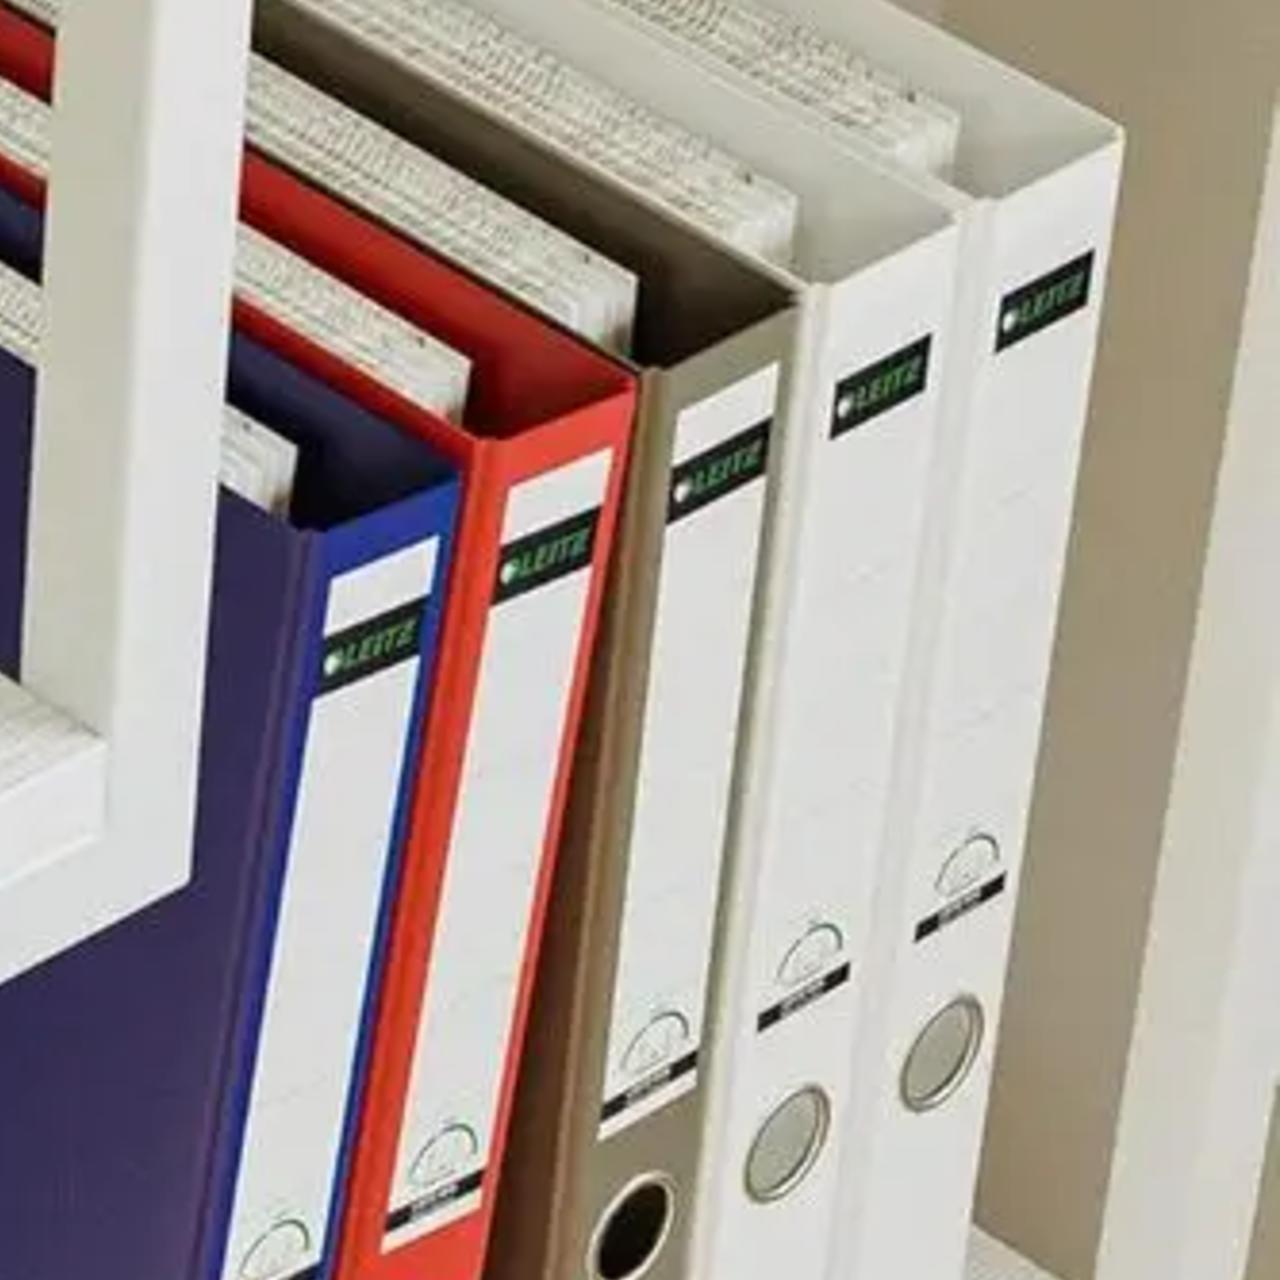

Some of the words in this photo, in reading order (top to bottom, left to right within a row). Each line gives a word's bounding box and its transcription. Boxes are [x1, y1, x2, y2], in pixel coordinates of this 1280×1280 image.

[854, 356, 922, 407] LEITZ
[690, 440, 761, 494] LEITZ
[512, 528, 591, 577] LEITZ
[342, 618, 418, 665] LEITZ
